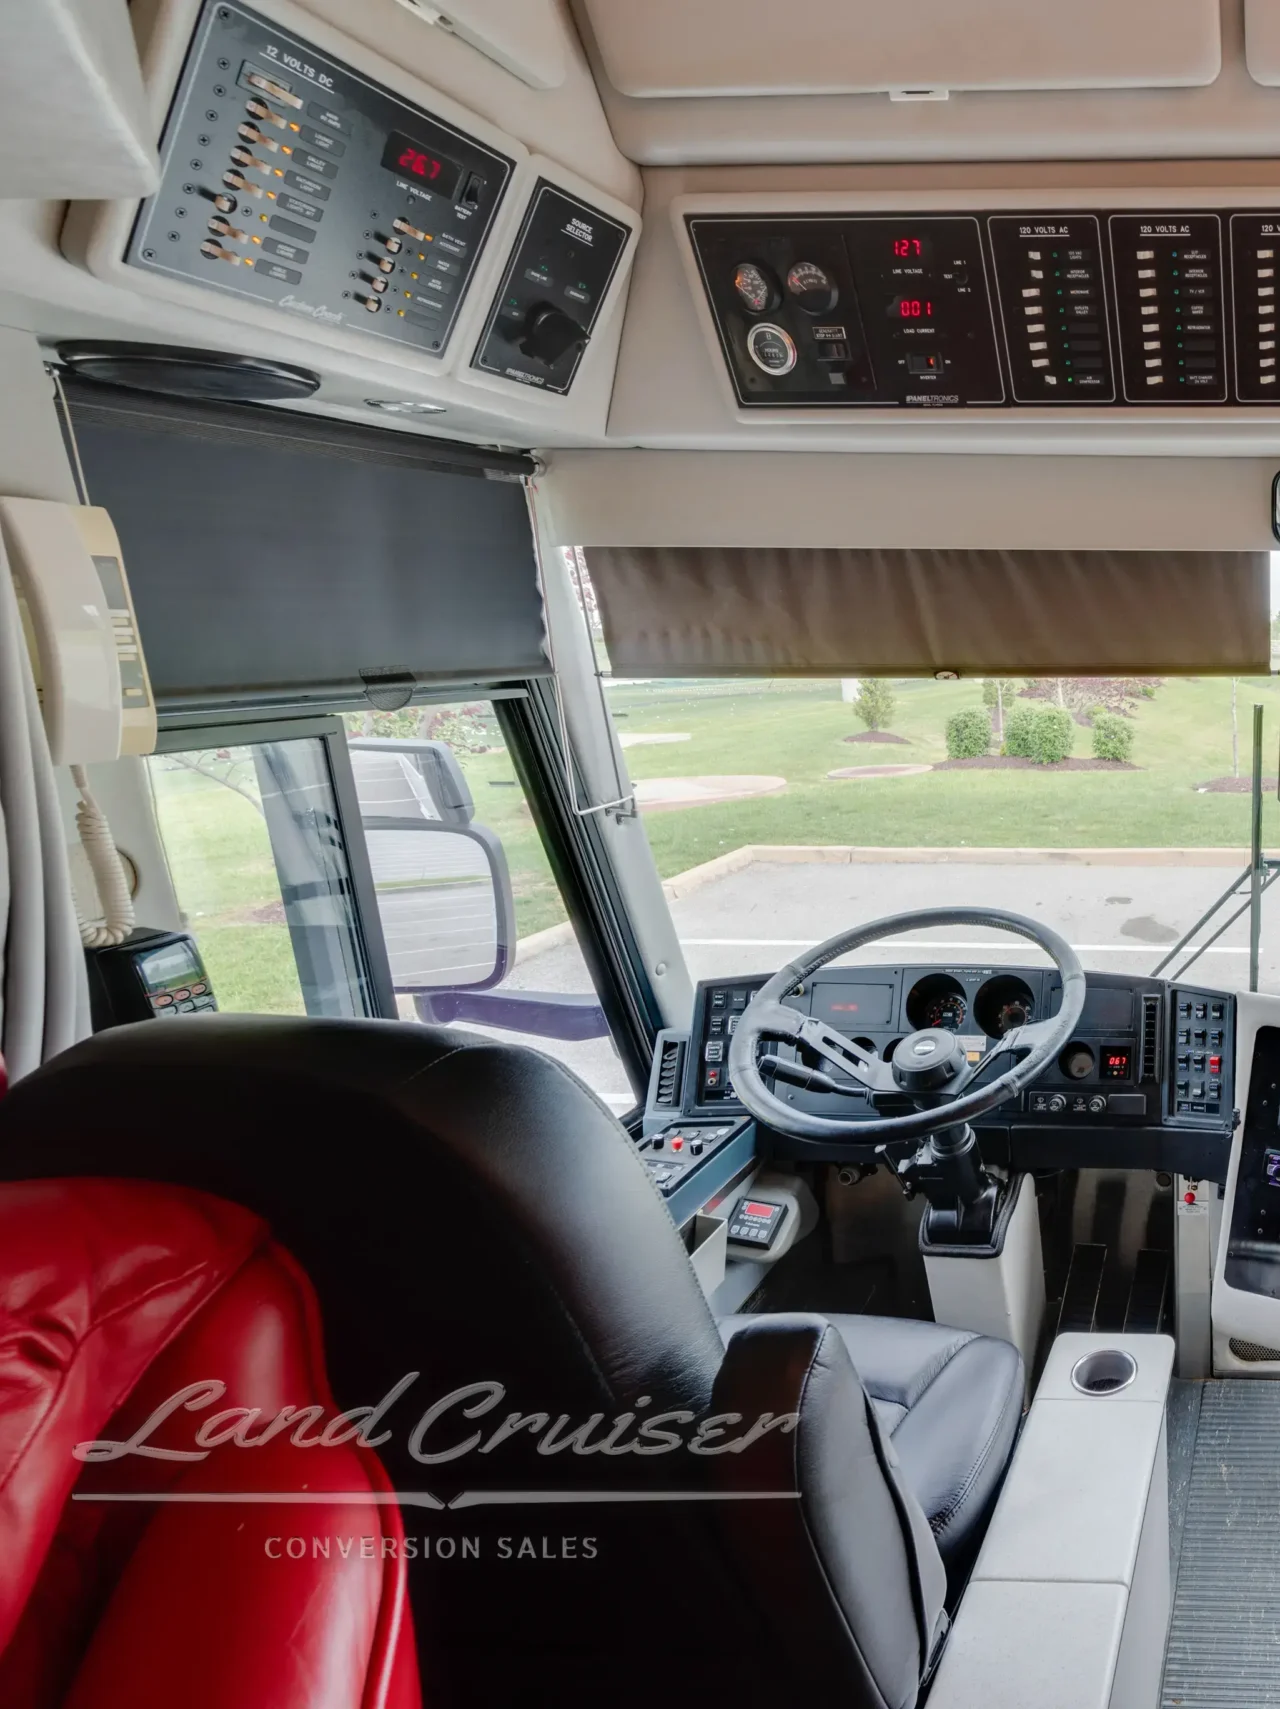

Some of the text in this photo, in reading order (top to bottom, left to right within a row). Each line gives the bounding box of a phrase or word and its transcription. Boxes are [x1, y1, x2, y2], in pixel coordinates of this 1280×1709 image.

[266, 45, 334, 87] 12 VOLTS DC
[396, 180, 432, 202] LINE VOLTAGE
[454, 205, 472, 216] BATTERY
[457, 212, 467, 220] TEST
[571, 217, 593, 234] SOURCE
[1019, 226, 1031, 234] 120
[1034, 226, 1056, 234] VOLTS
[1140, 225, 1190, 233] 120 VOLTS AC
[1261, 224, 1273, 232] 120
[565, 224, 593, 242] SELECTOR
[894, 240, 922, 256] 127
[901, 301, 931, 317] 001
[905, 395, 959, 404] PANELTRONICS
[1109, 1057, 1126, 1065] 067
